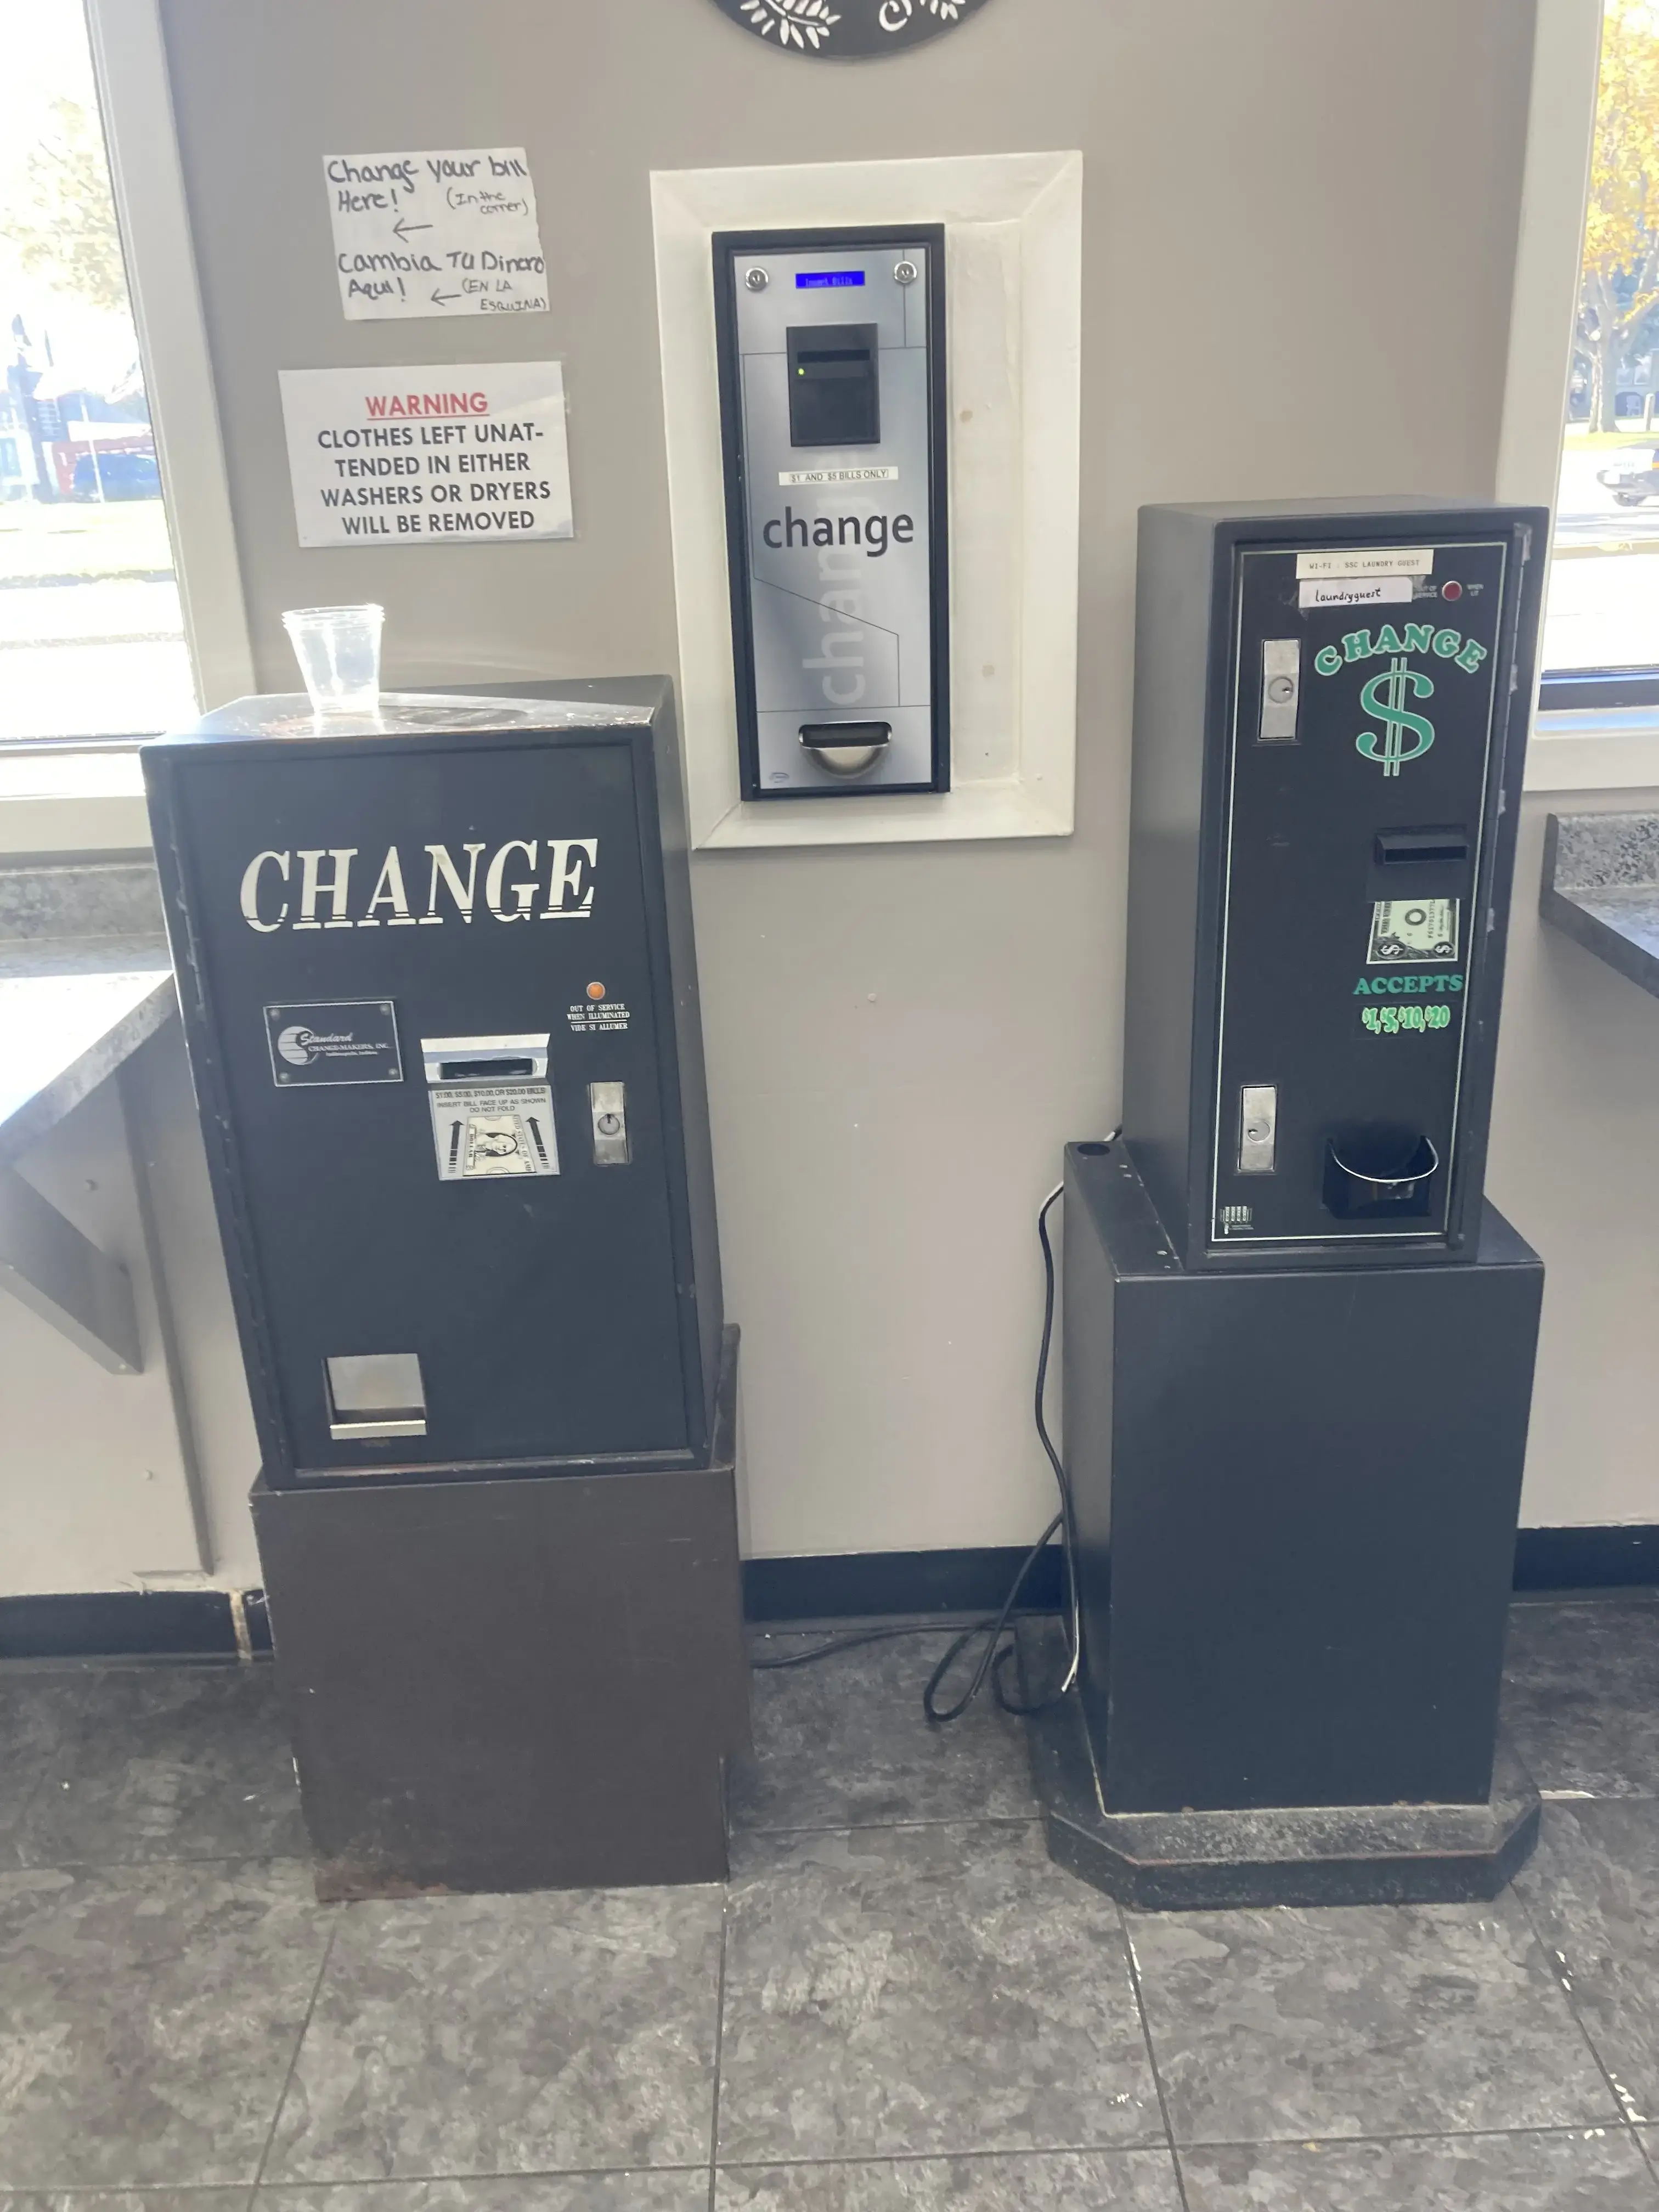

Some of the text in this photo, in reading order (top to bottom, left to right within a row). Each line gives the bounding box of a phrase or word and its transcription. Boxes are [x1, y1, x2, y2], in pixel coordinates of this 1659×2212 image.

[328, 155, 527, 193] Change your bill
[338, 189, 399, 213] Here!
[446, 187, 506, 210] (In the
[338, 251, 443, 273] Cambia
[482, 250, 545, 274] Dinero
[348, 276, 406, 302] Aqui!
[462, 278, 513, 293] (EN LA
[480, 297, 546, 312] ESQUINA)
[365, 392, 490, 417] WARNING
[318, 422, 544, 449] CLOTHES LEFT UNAT-
[335, 453, 531, 477] TENDED IN EITHER
[791, 474, 800, 483] $1
[827, 472, 837, 481] $5
[839, 471, 861, 479] BILLS
[864, 470, 886, 478] ONLY
[320, 481, 550, 507] WASHERS OR DRYERS
[342, 510, 534, 535] WILL BE REMOVED
[763, 506, 914, 558] change
[1315, 623, 1487, 675] CHANGE
[240, 838, 598, 933] CHANGE
[1352, 974, 1464, 995] ACCEPTS
[300, 1032, 353, 1046] Standard
